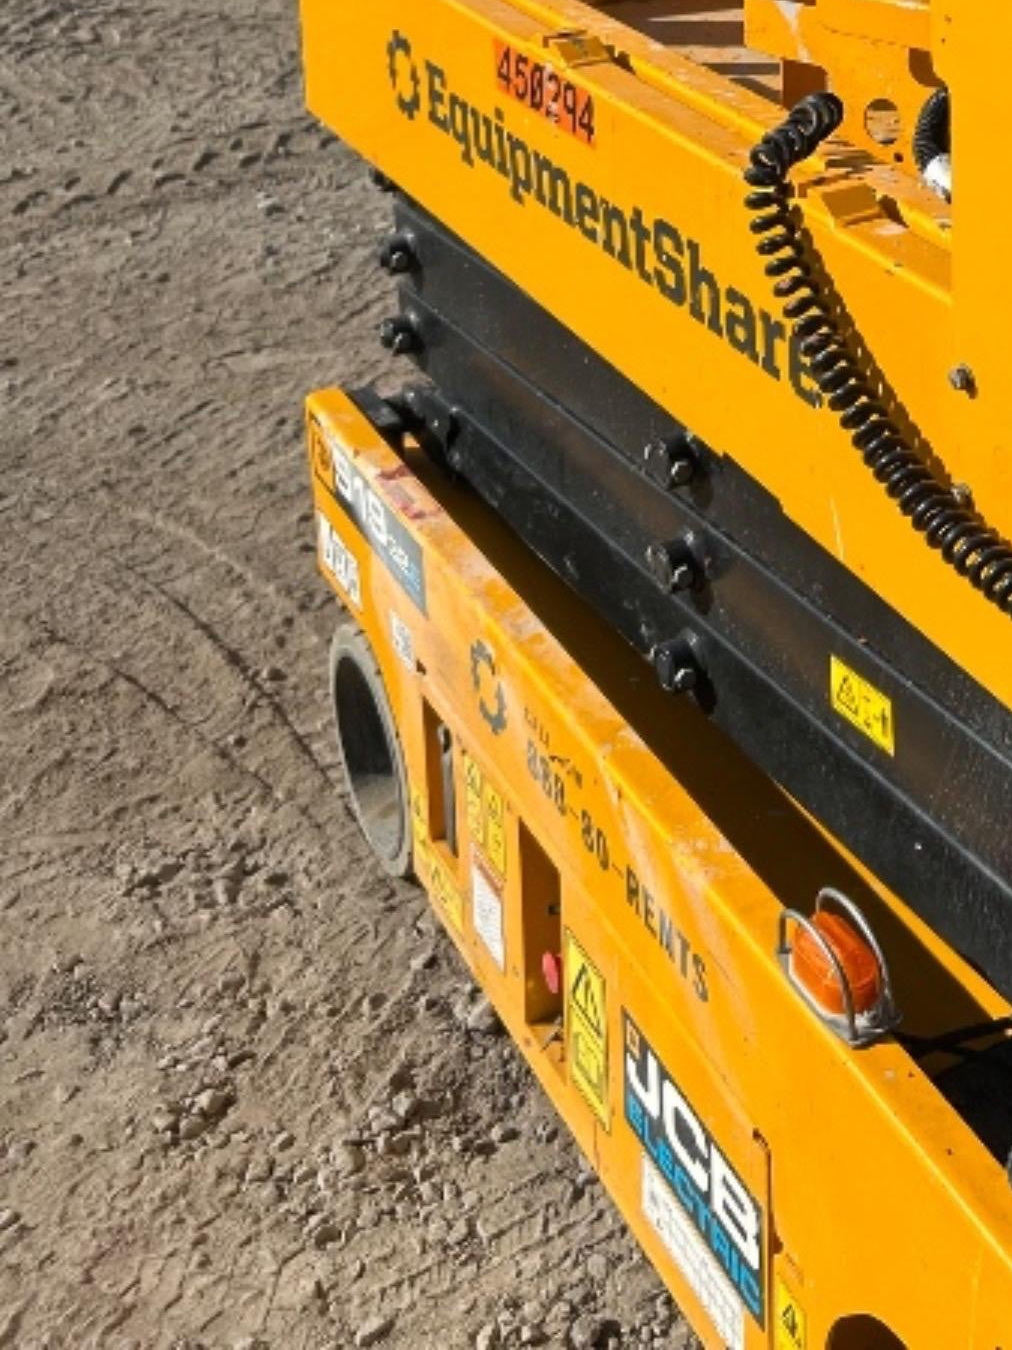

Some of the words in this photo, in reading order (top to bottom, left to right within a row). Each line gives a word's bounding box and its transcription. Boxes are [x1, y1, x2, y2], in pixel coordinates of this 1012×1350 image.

[497, 45, 595, 145] 450294
[424, 58, 824, 409] EquipmentShare
[625, 1048, 761, 1271] JCB
[626, 1096, 761, 1317] ELECTRIC
